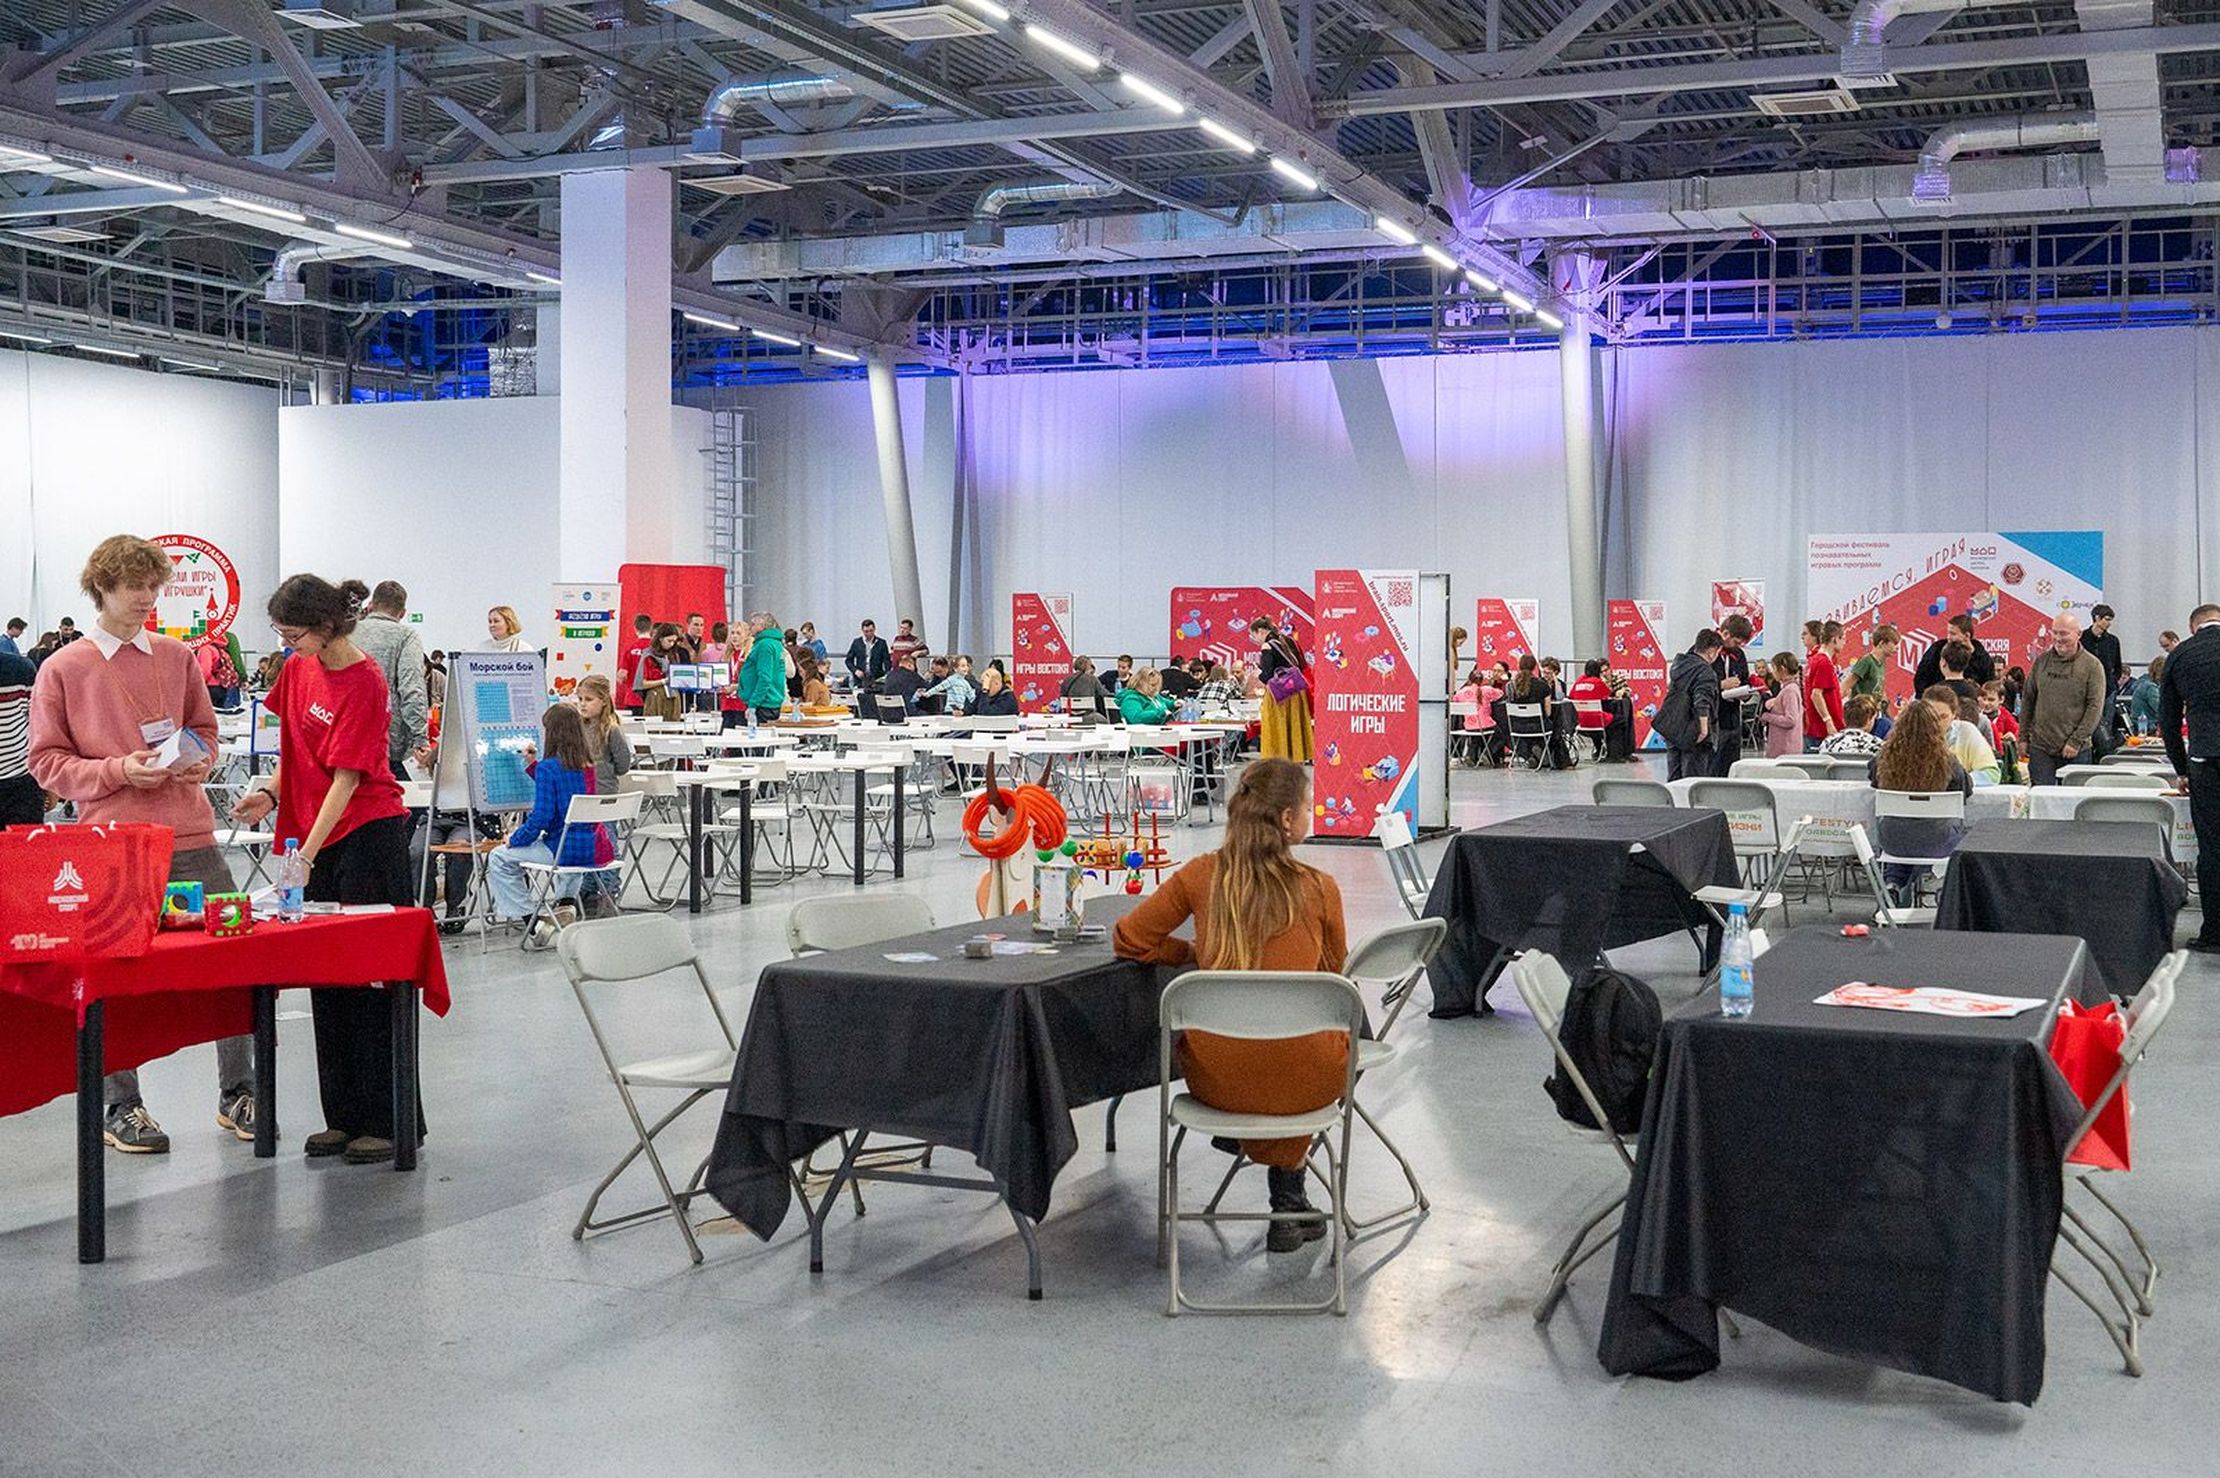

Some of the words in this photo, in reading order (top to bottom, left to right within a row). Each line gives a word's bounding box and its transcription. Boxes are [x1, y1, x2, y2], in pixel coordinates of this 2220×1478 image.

[182, 537, 232, 574] ПРОГРАММА
[1926, 536, 1966, 573] ИГРАЯ
[469, 662, 514, 673] Морской
[515, 662, 534, 672] бой
[1016, 663, 1036, 674] ИГРЫ
[1037, 663, 1070, 674] ВОСТОКА
[1633, 669, 1664, 679] ВОСТОКА
[1327, 693, 1406, 712] ЛОГИЧЕСКИЕ
[1350, 716, 1386, 733] ИГРЫ
